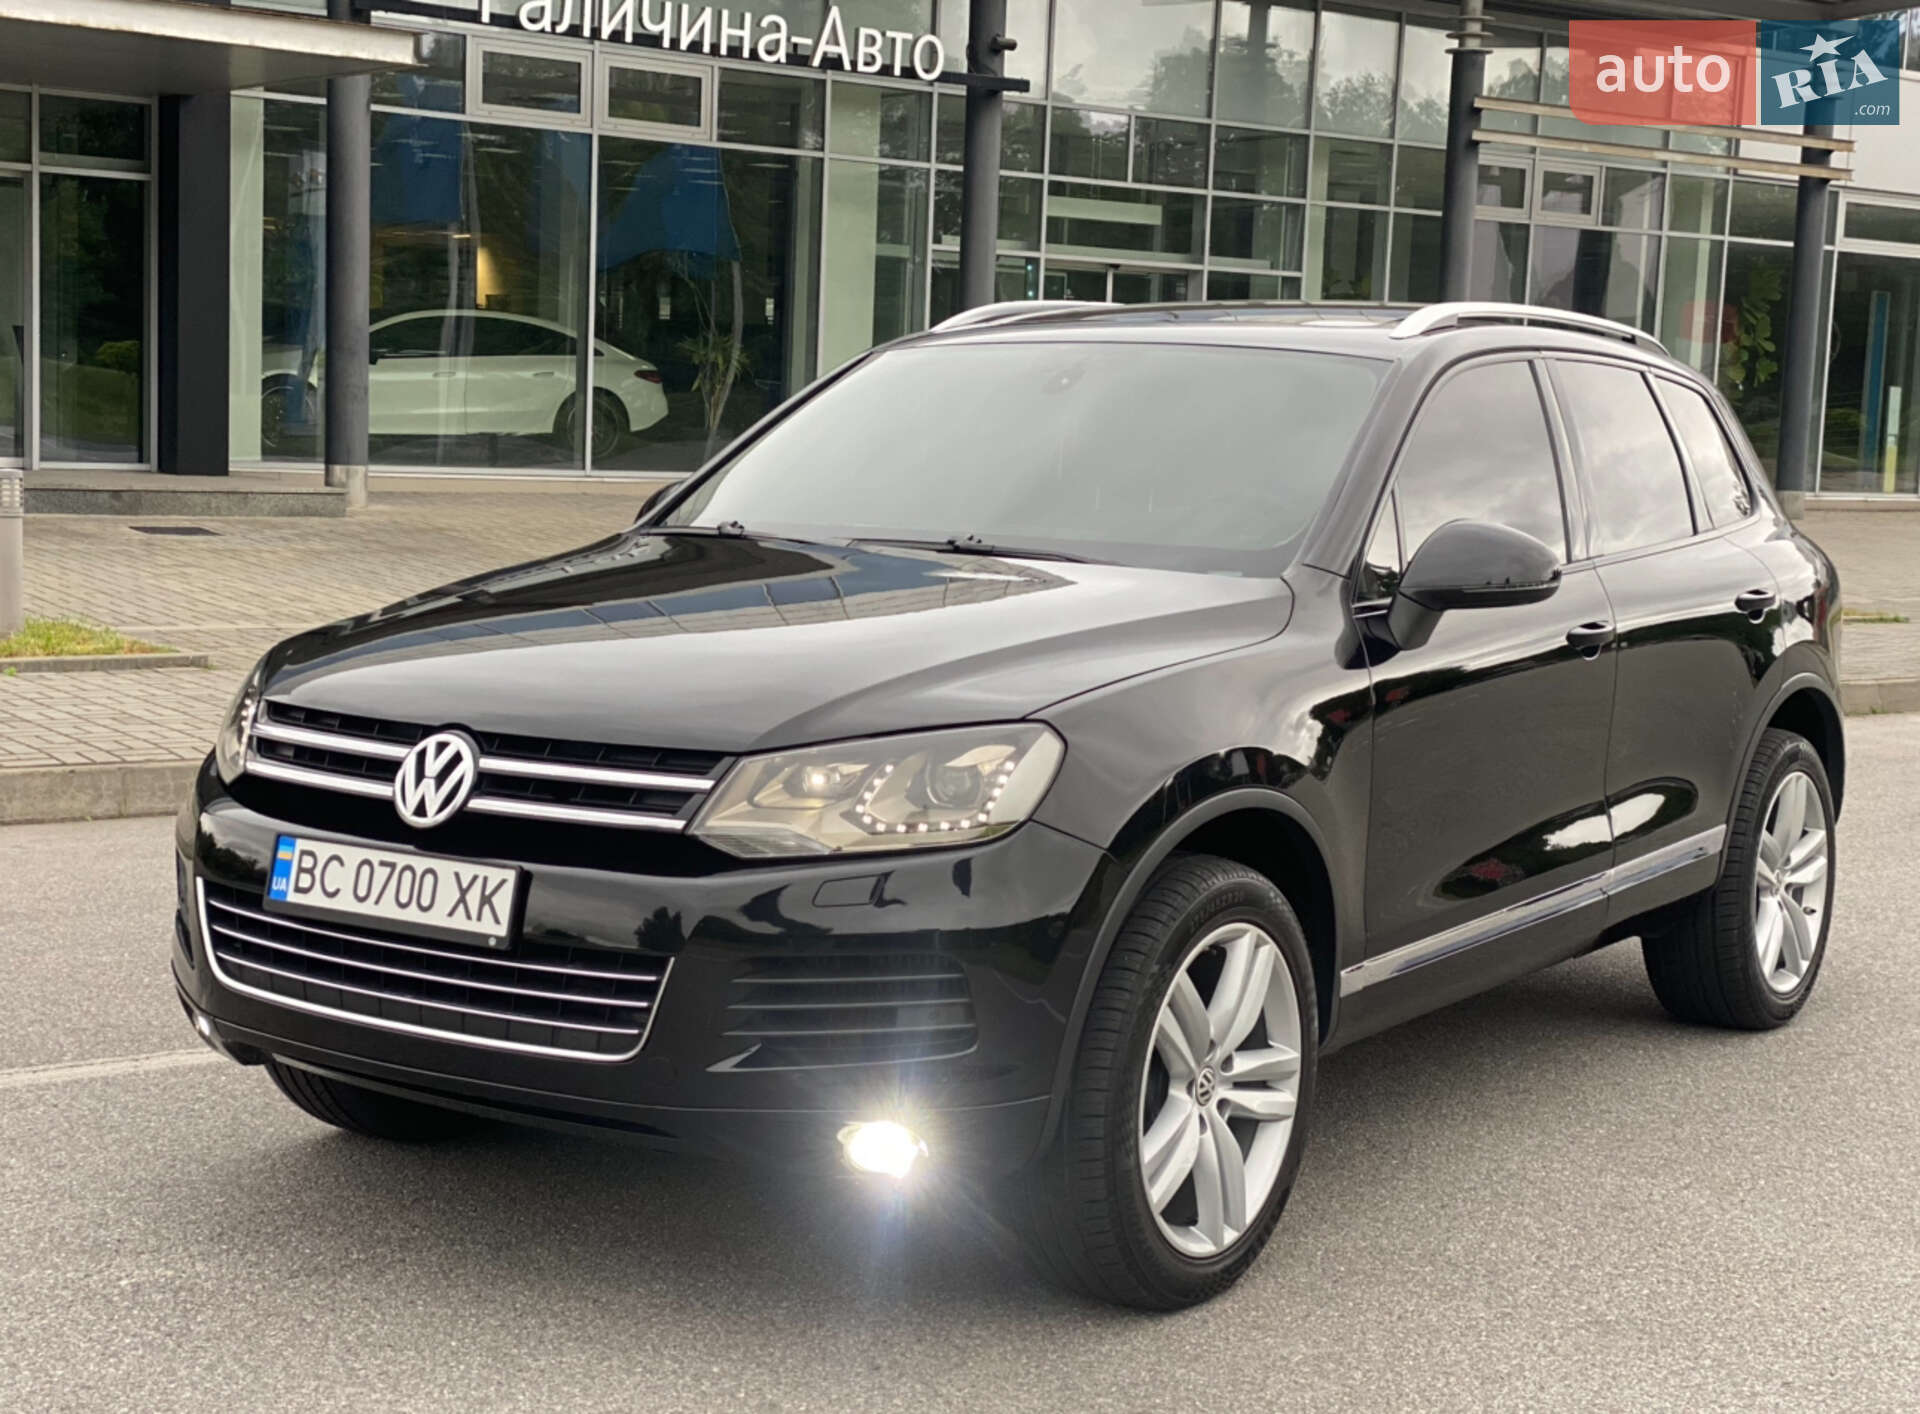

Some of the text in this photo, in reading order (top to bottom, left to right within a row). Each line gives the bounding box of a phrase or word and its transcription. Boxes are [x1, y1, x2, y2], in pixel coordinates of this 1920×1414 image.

[271, 876, 287, 892] UA
[293, 849, 509, 926] BC 0700 XK
